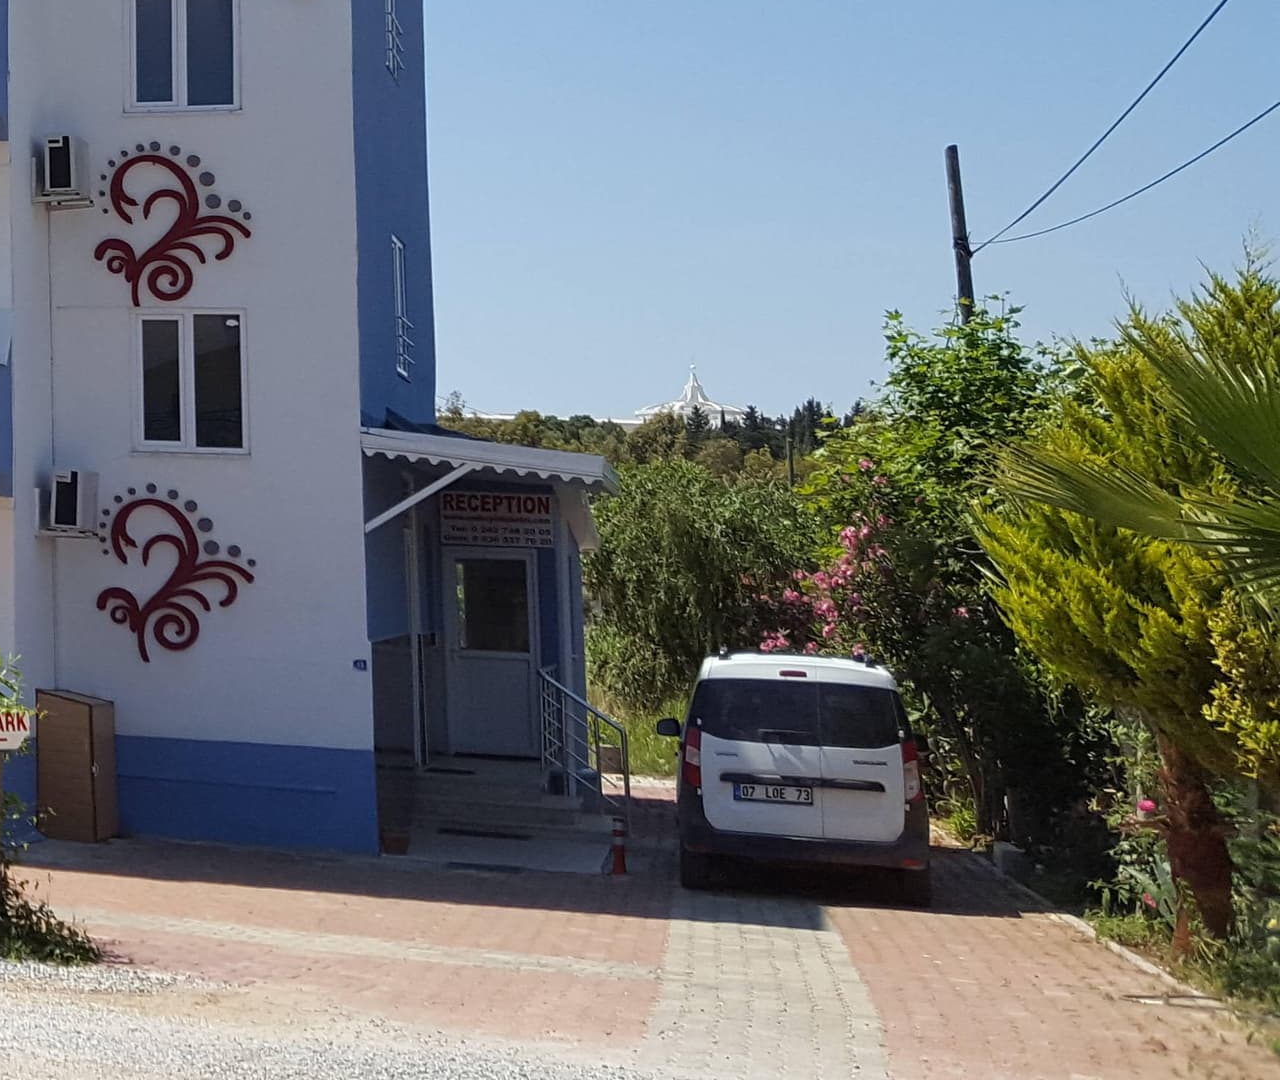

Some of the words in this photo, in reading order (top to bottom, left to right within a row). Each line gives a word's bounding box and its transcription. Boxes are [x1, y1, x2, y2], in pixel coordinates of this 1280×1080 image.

[443, 493, 550, 515] RECEPTION
[742, 786, 755, 797] 07
[765, 787, 786, 799] LOE
[795, 789, 810, 801] 73
